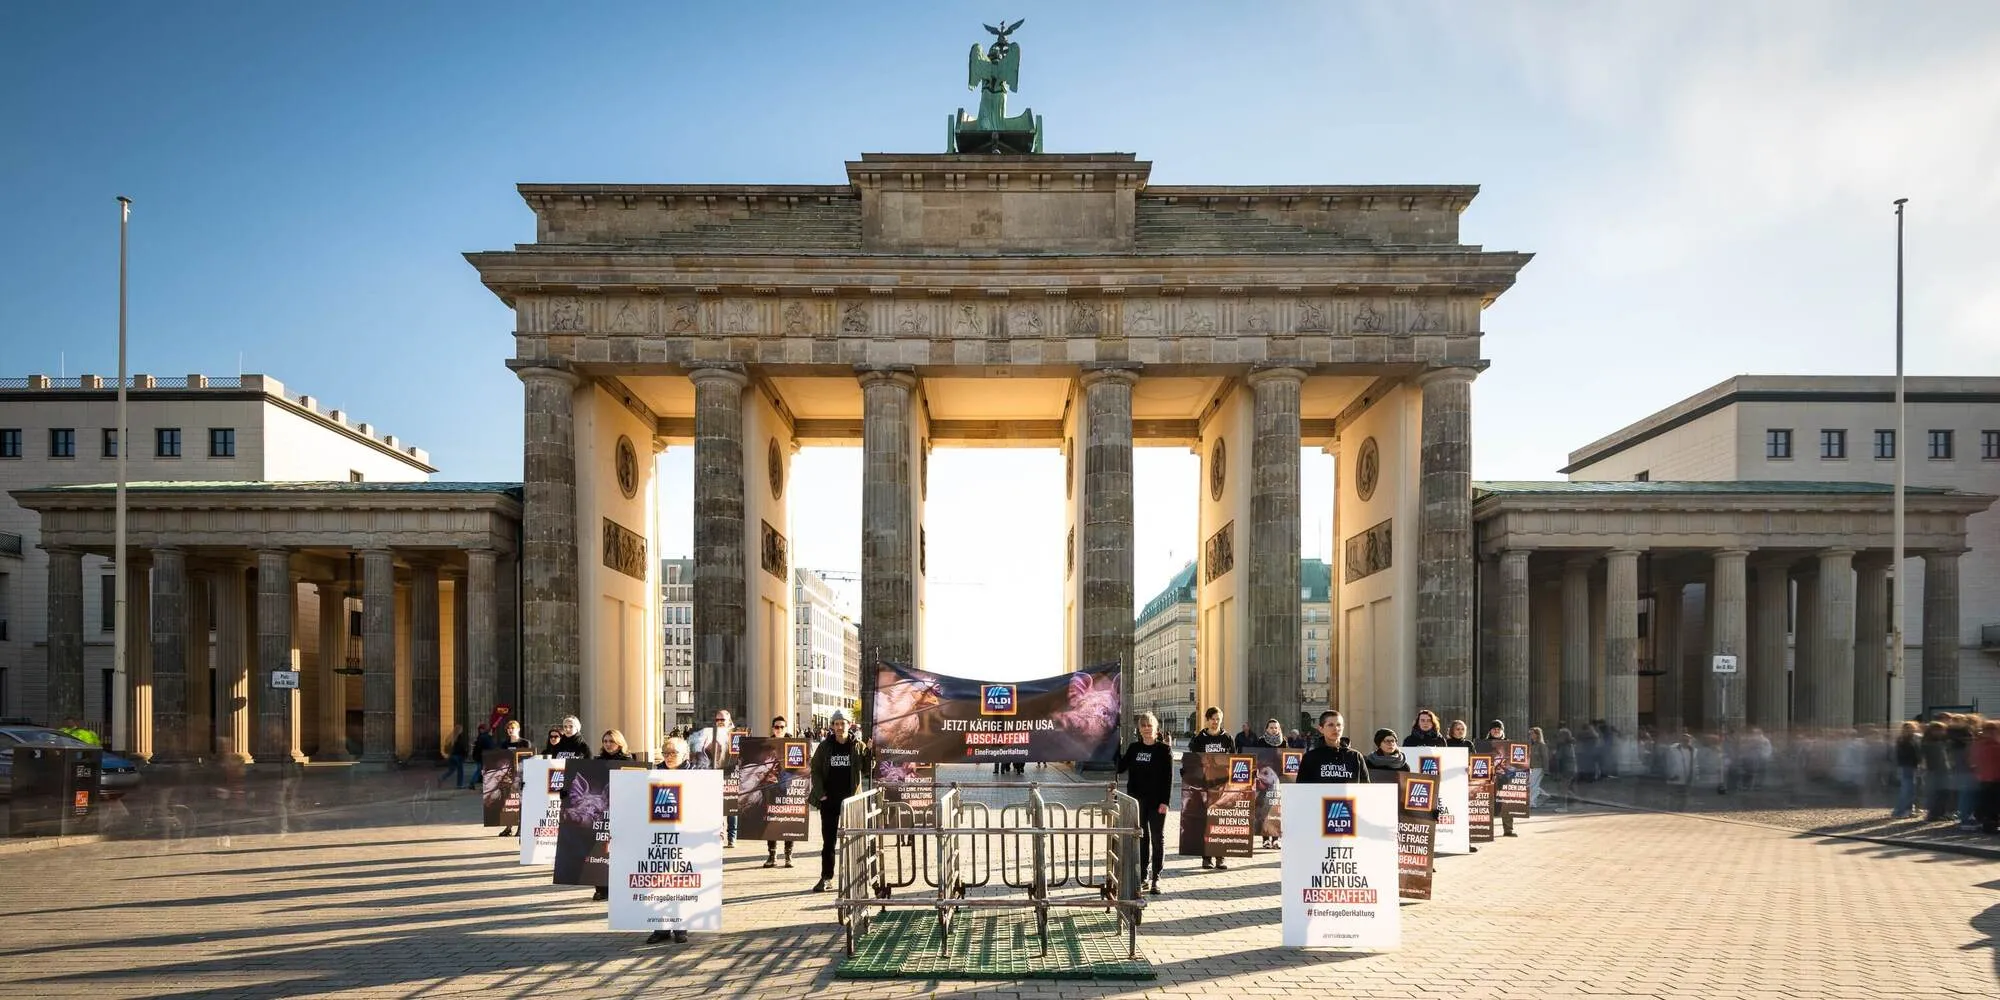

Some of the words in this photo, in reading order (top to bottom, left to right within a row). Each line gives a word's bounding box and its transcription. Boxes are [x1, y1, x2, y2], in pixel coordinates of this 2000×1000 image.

[941, 721, 968, 731] JETZT
[969, 719, 1003, 731] KÄFIGE
[1004, 720, 1013, 730] IN
[1015, 720, 1033, 730] DEN
[1035, 719, 1054, 730] USA
[966, 733, 1029, 744] ABSCHAFFEN!
[1321, 763, 1347, 773] animal
[654, 806, 678, 814] ALDI
[1207, 808, 1250, 817] KASTENSTÄNDE
[539, 819, 547, 827] IN
[592, 822, 603, 830] IST
[1219, 817, 1225, 825] IN
[1226, 817, 1237, 825] DEN
[1237, 817, 1250, 826] USA
[1210, 826, 1250, 835] ABSCHAFFEN!
[1398, 823, 1430, 834] RSCHUTZ
[651, 832, 680, 845] JETZT
[1406, 834, 1429, 845] FRAGE
[648, 845, 683, 859] KÄFIGE
[1324, 847, 1354, 859] JETZT
[1398, 855, 1428, 866] BERALL!
[638, 861, 649, 873] IN
[650, 861, 671, 873] DEN
[672, 861, 693, 873] USA
[1321, 860, 1357, 874] KÄFIGE
[630, 874, 700, 888] ABSCHAFFEN!
[1311, 876, 1322, 888] IN
[1324, 876, 1344, 888] DEN
[1347, 876, 1368, 888] USA
[1304, 889, 1376, 903] ABSCHAFFEN!
